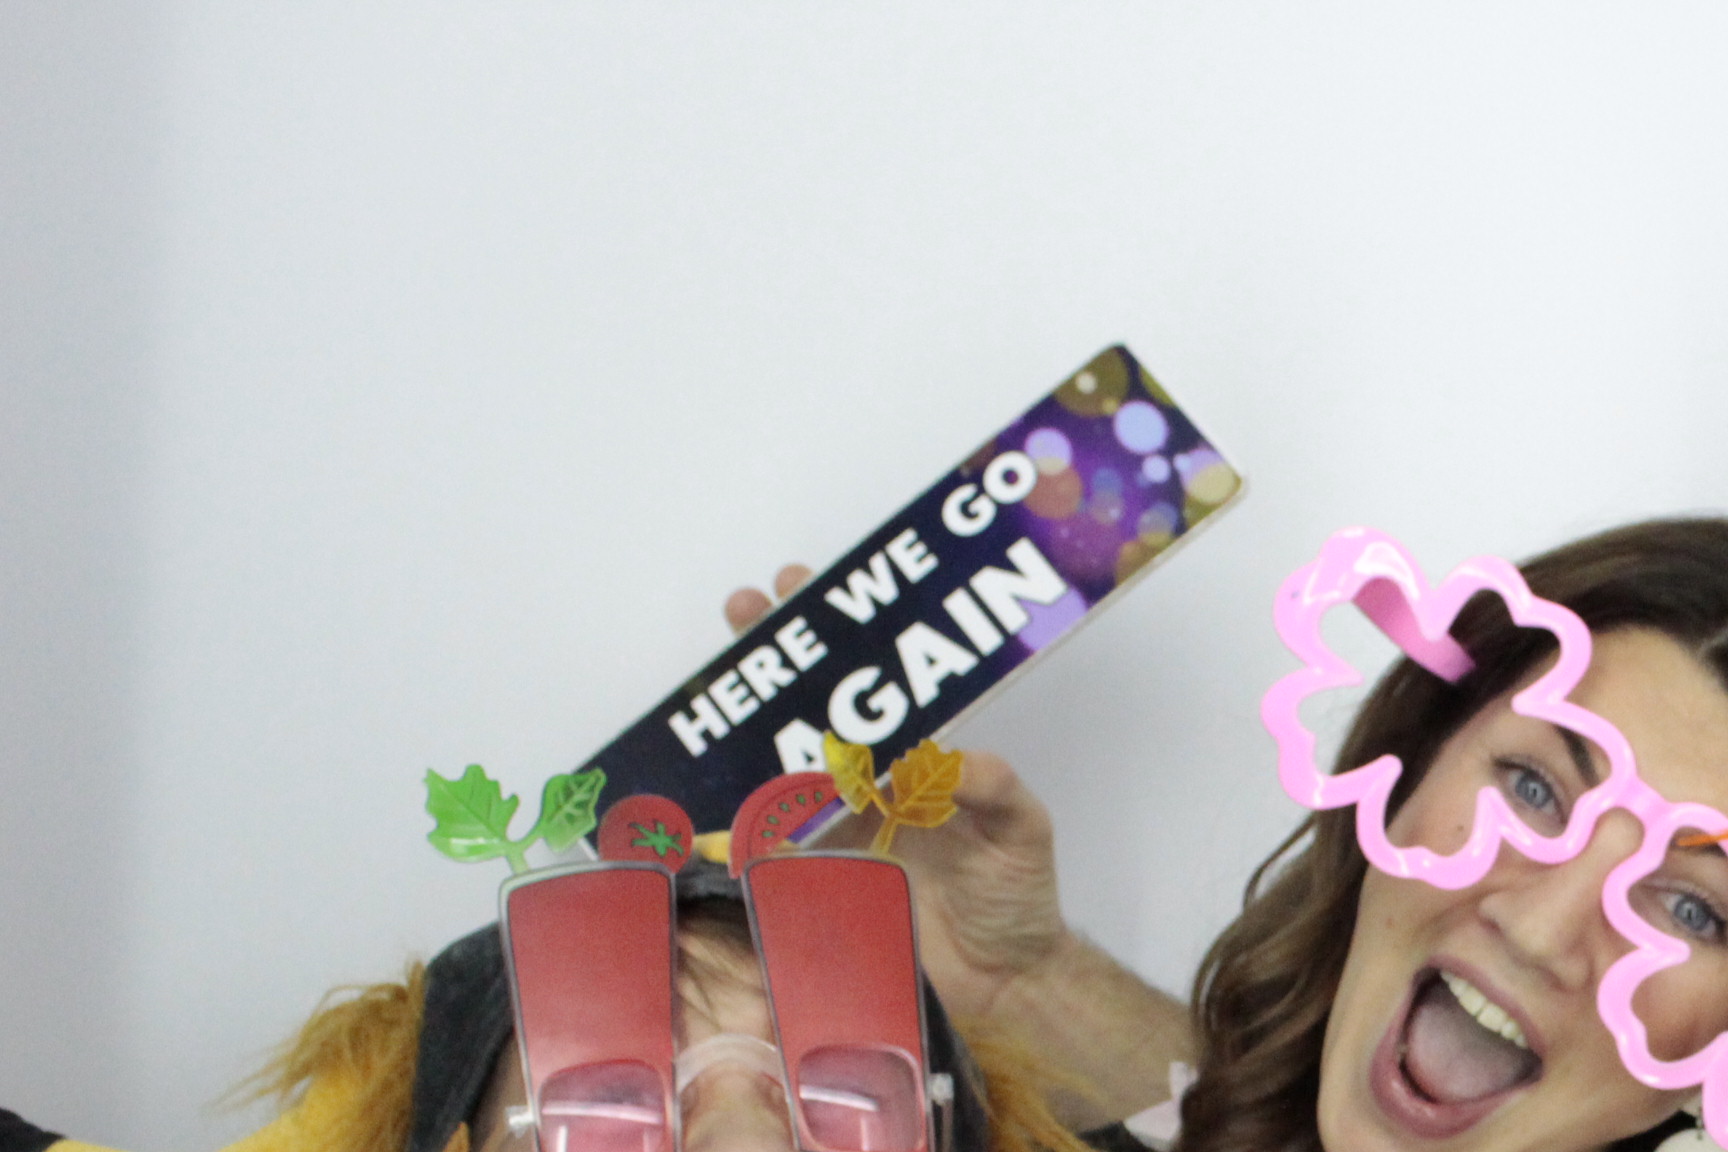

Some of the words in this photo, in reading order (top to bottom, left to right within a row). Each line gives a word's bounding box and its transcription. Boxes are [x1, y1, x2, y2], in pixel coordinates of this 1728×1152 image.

[669, 617, 828, 758] HERE
[826, 529, 938, 624] WE
[942, 452, 1037, 537] GO
[774, 538, 1068, 775] AGAIN
